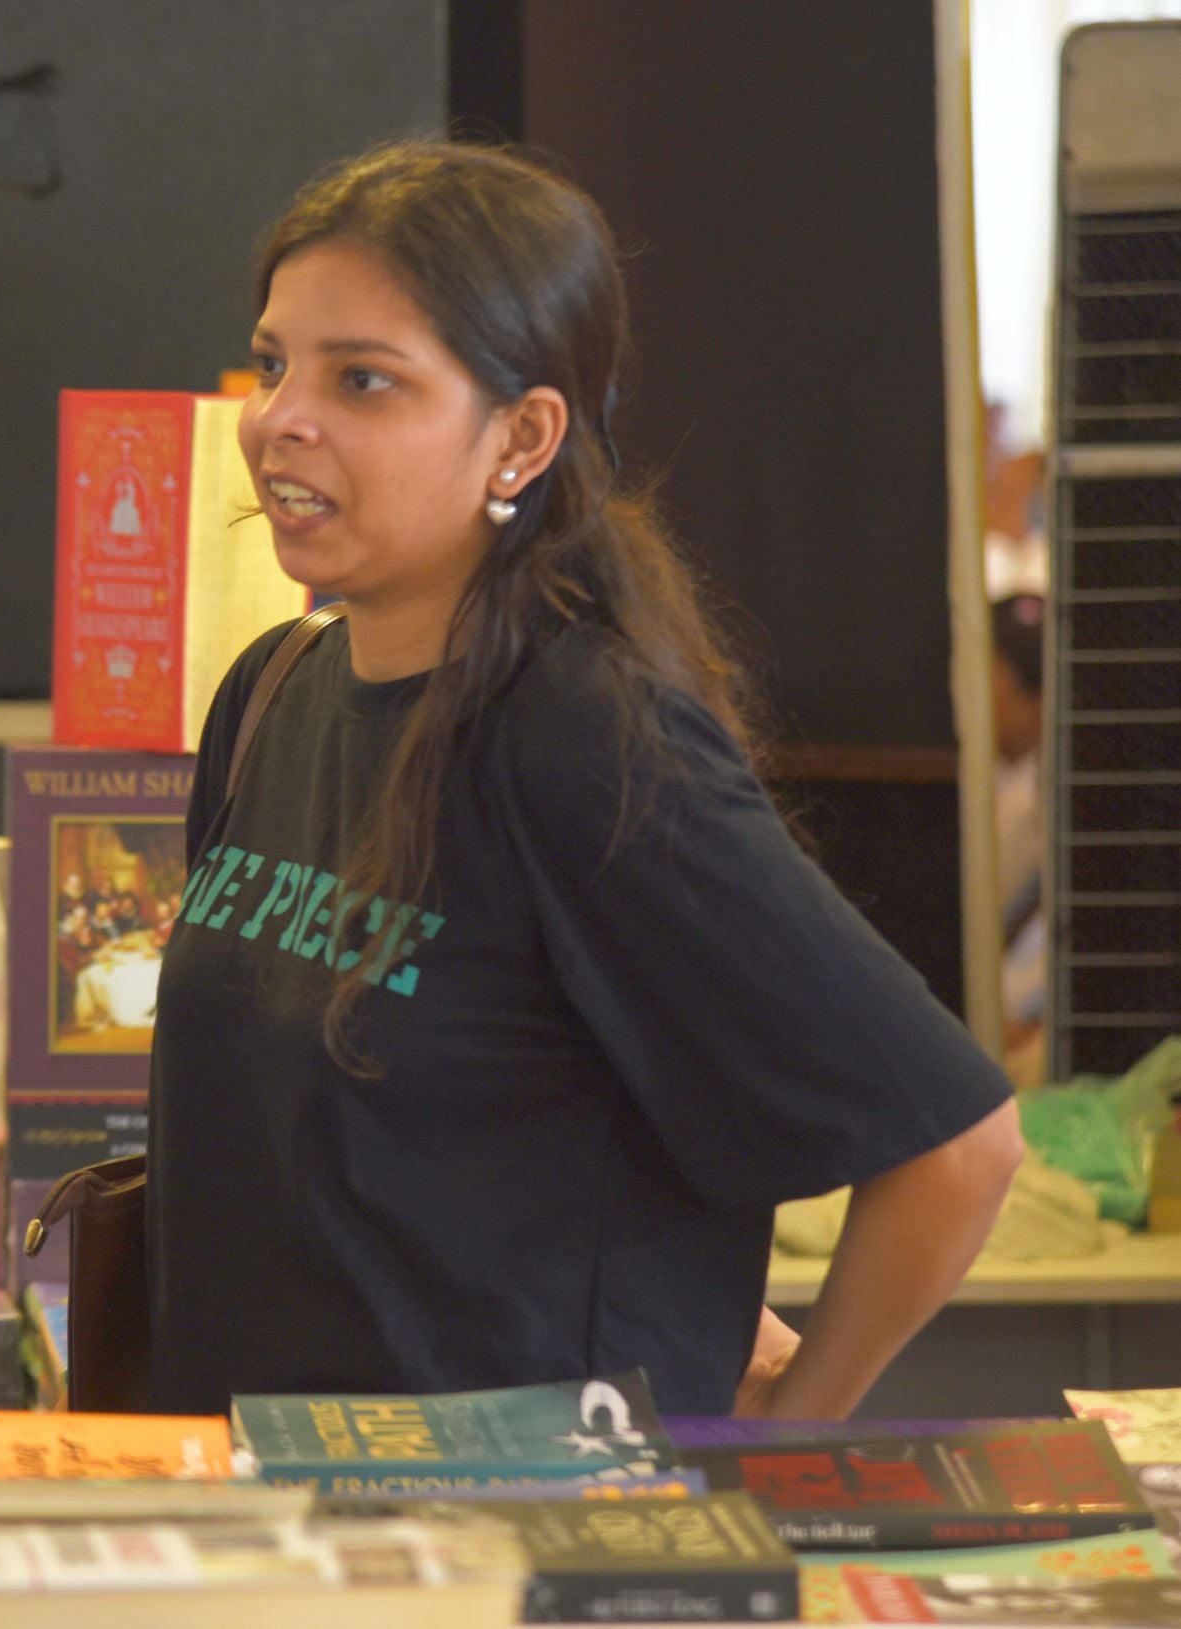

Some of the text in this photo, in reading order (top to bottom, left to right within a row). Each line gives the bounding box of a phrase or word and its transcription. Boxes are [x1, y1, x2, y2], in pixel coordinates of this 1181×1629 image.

[23, 771, 137, 797] WILLIAM
[238, 860, 447, 997] PIECE
[349, 1401, 444, 1461] PATH
